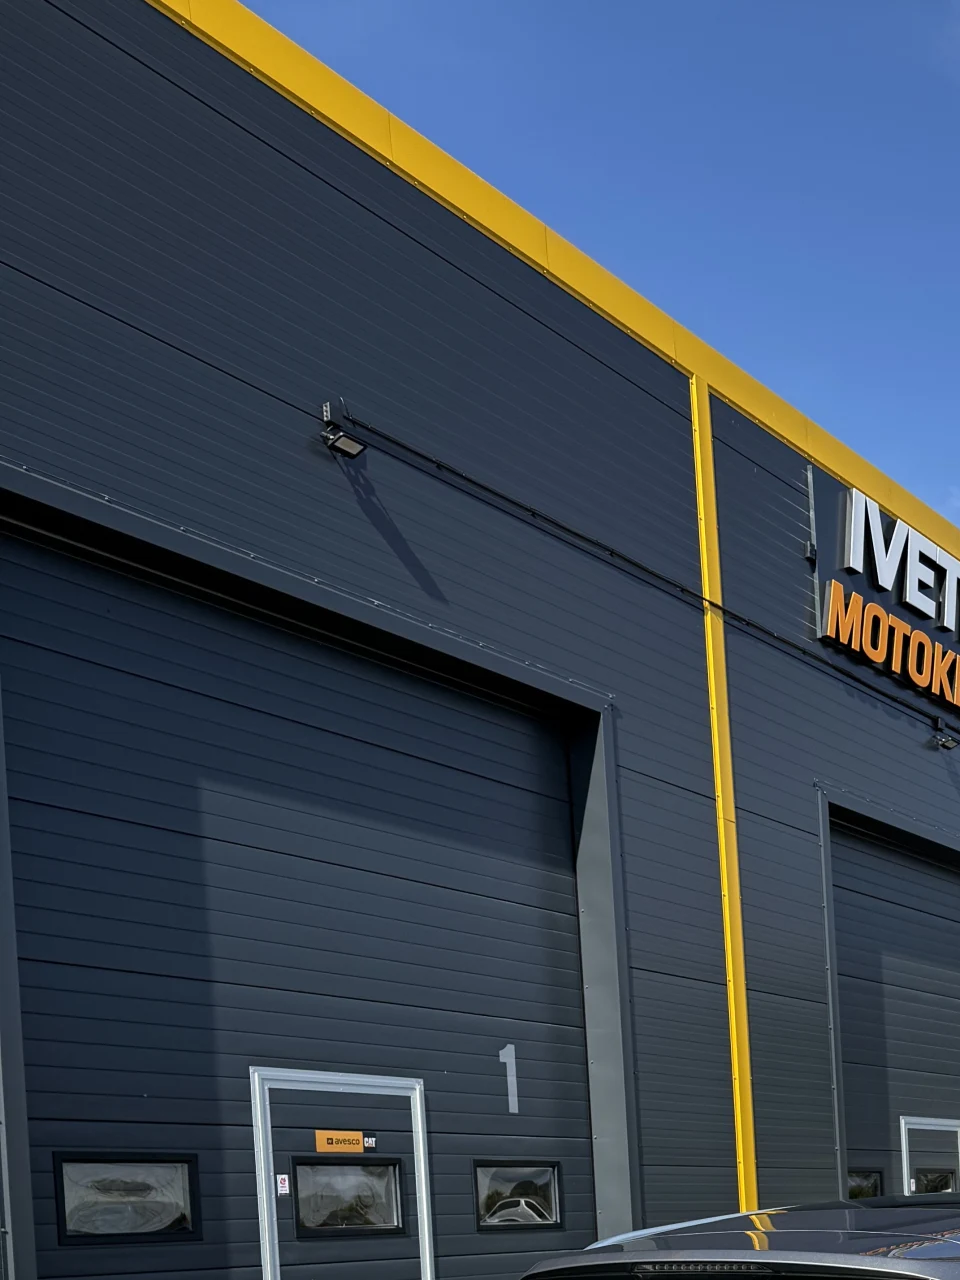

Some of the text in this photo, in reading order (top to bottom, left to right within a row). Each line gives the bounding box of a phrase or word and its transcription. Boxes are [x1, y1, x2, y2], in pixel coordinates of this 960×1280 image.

[498, 1043, 519, 1114] 1
[334, 1137, 377, 1148] avesco CAT
